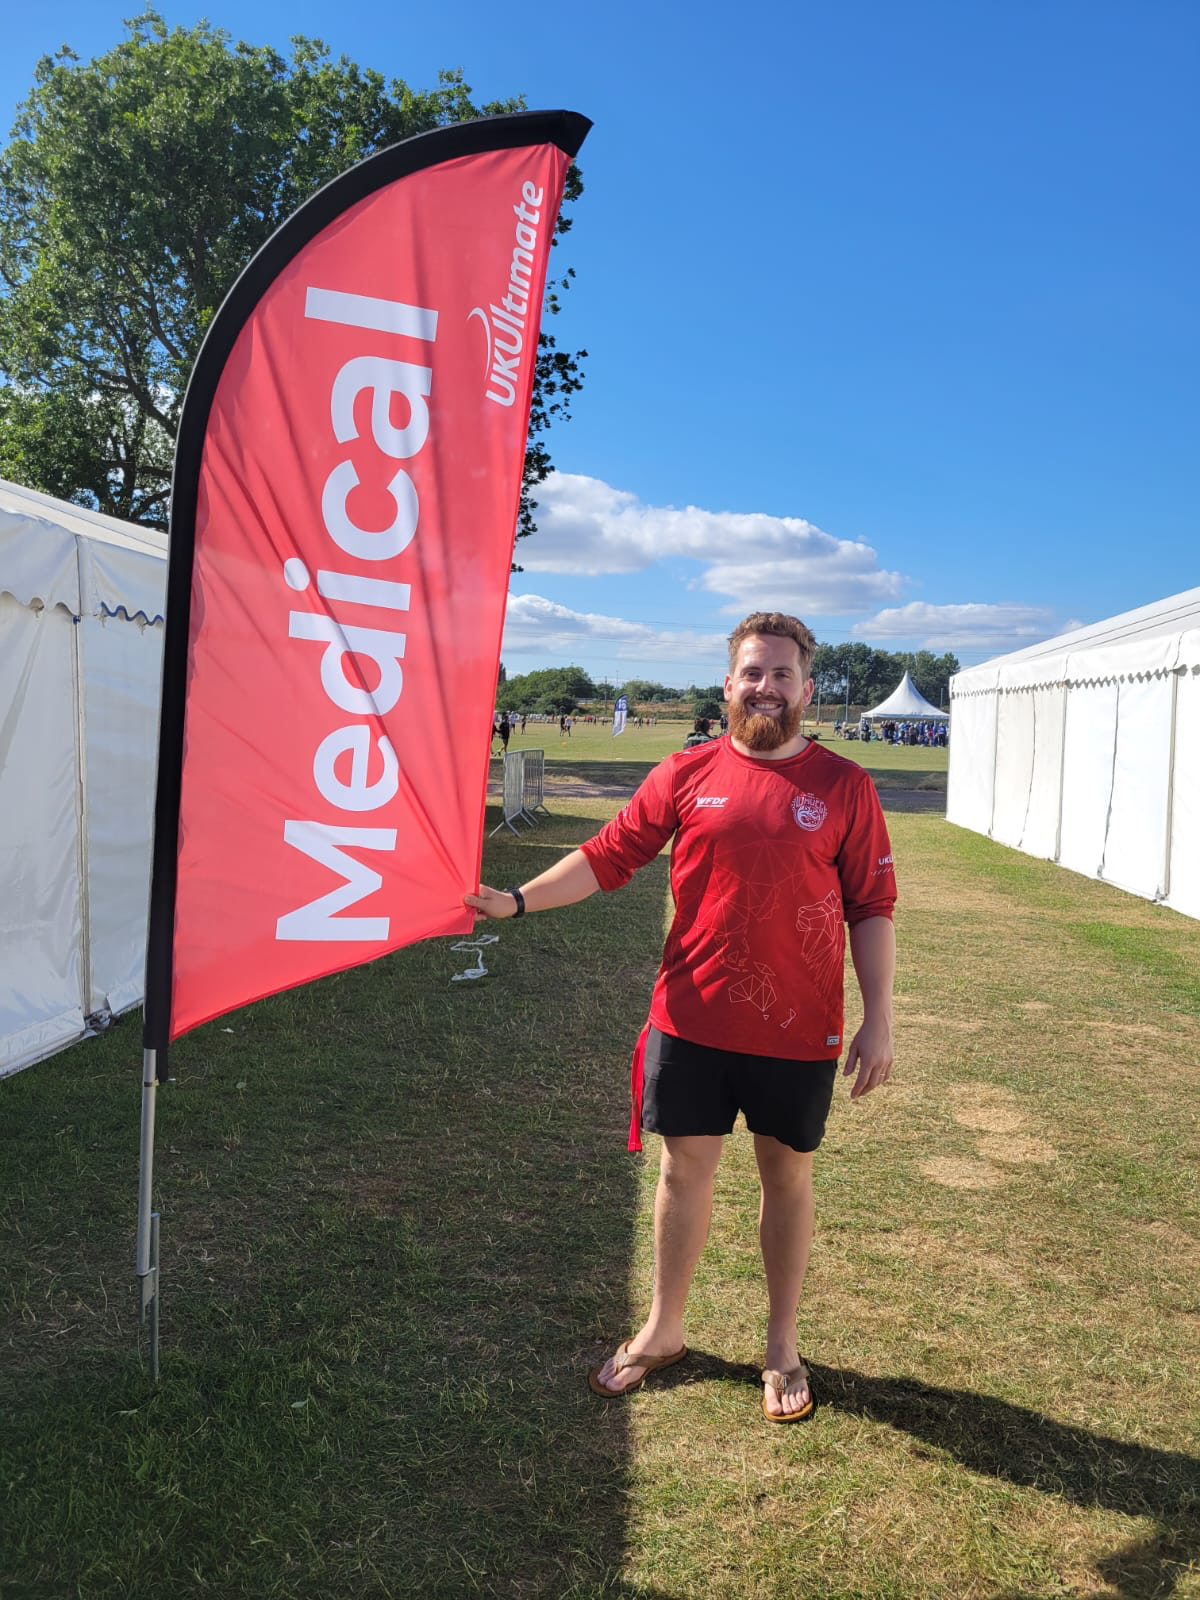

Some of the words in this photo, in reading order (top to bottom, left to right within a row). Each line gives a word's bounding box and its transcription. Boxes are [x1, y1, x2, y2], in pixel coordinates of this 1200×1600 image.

[485, 180, 543, 407] UKUltimate
[275, 286, 438, 942] Medical
[696, 797, 729, 805] WFDF
